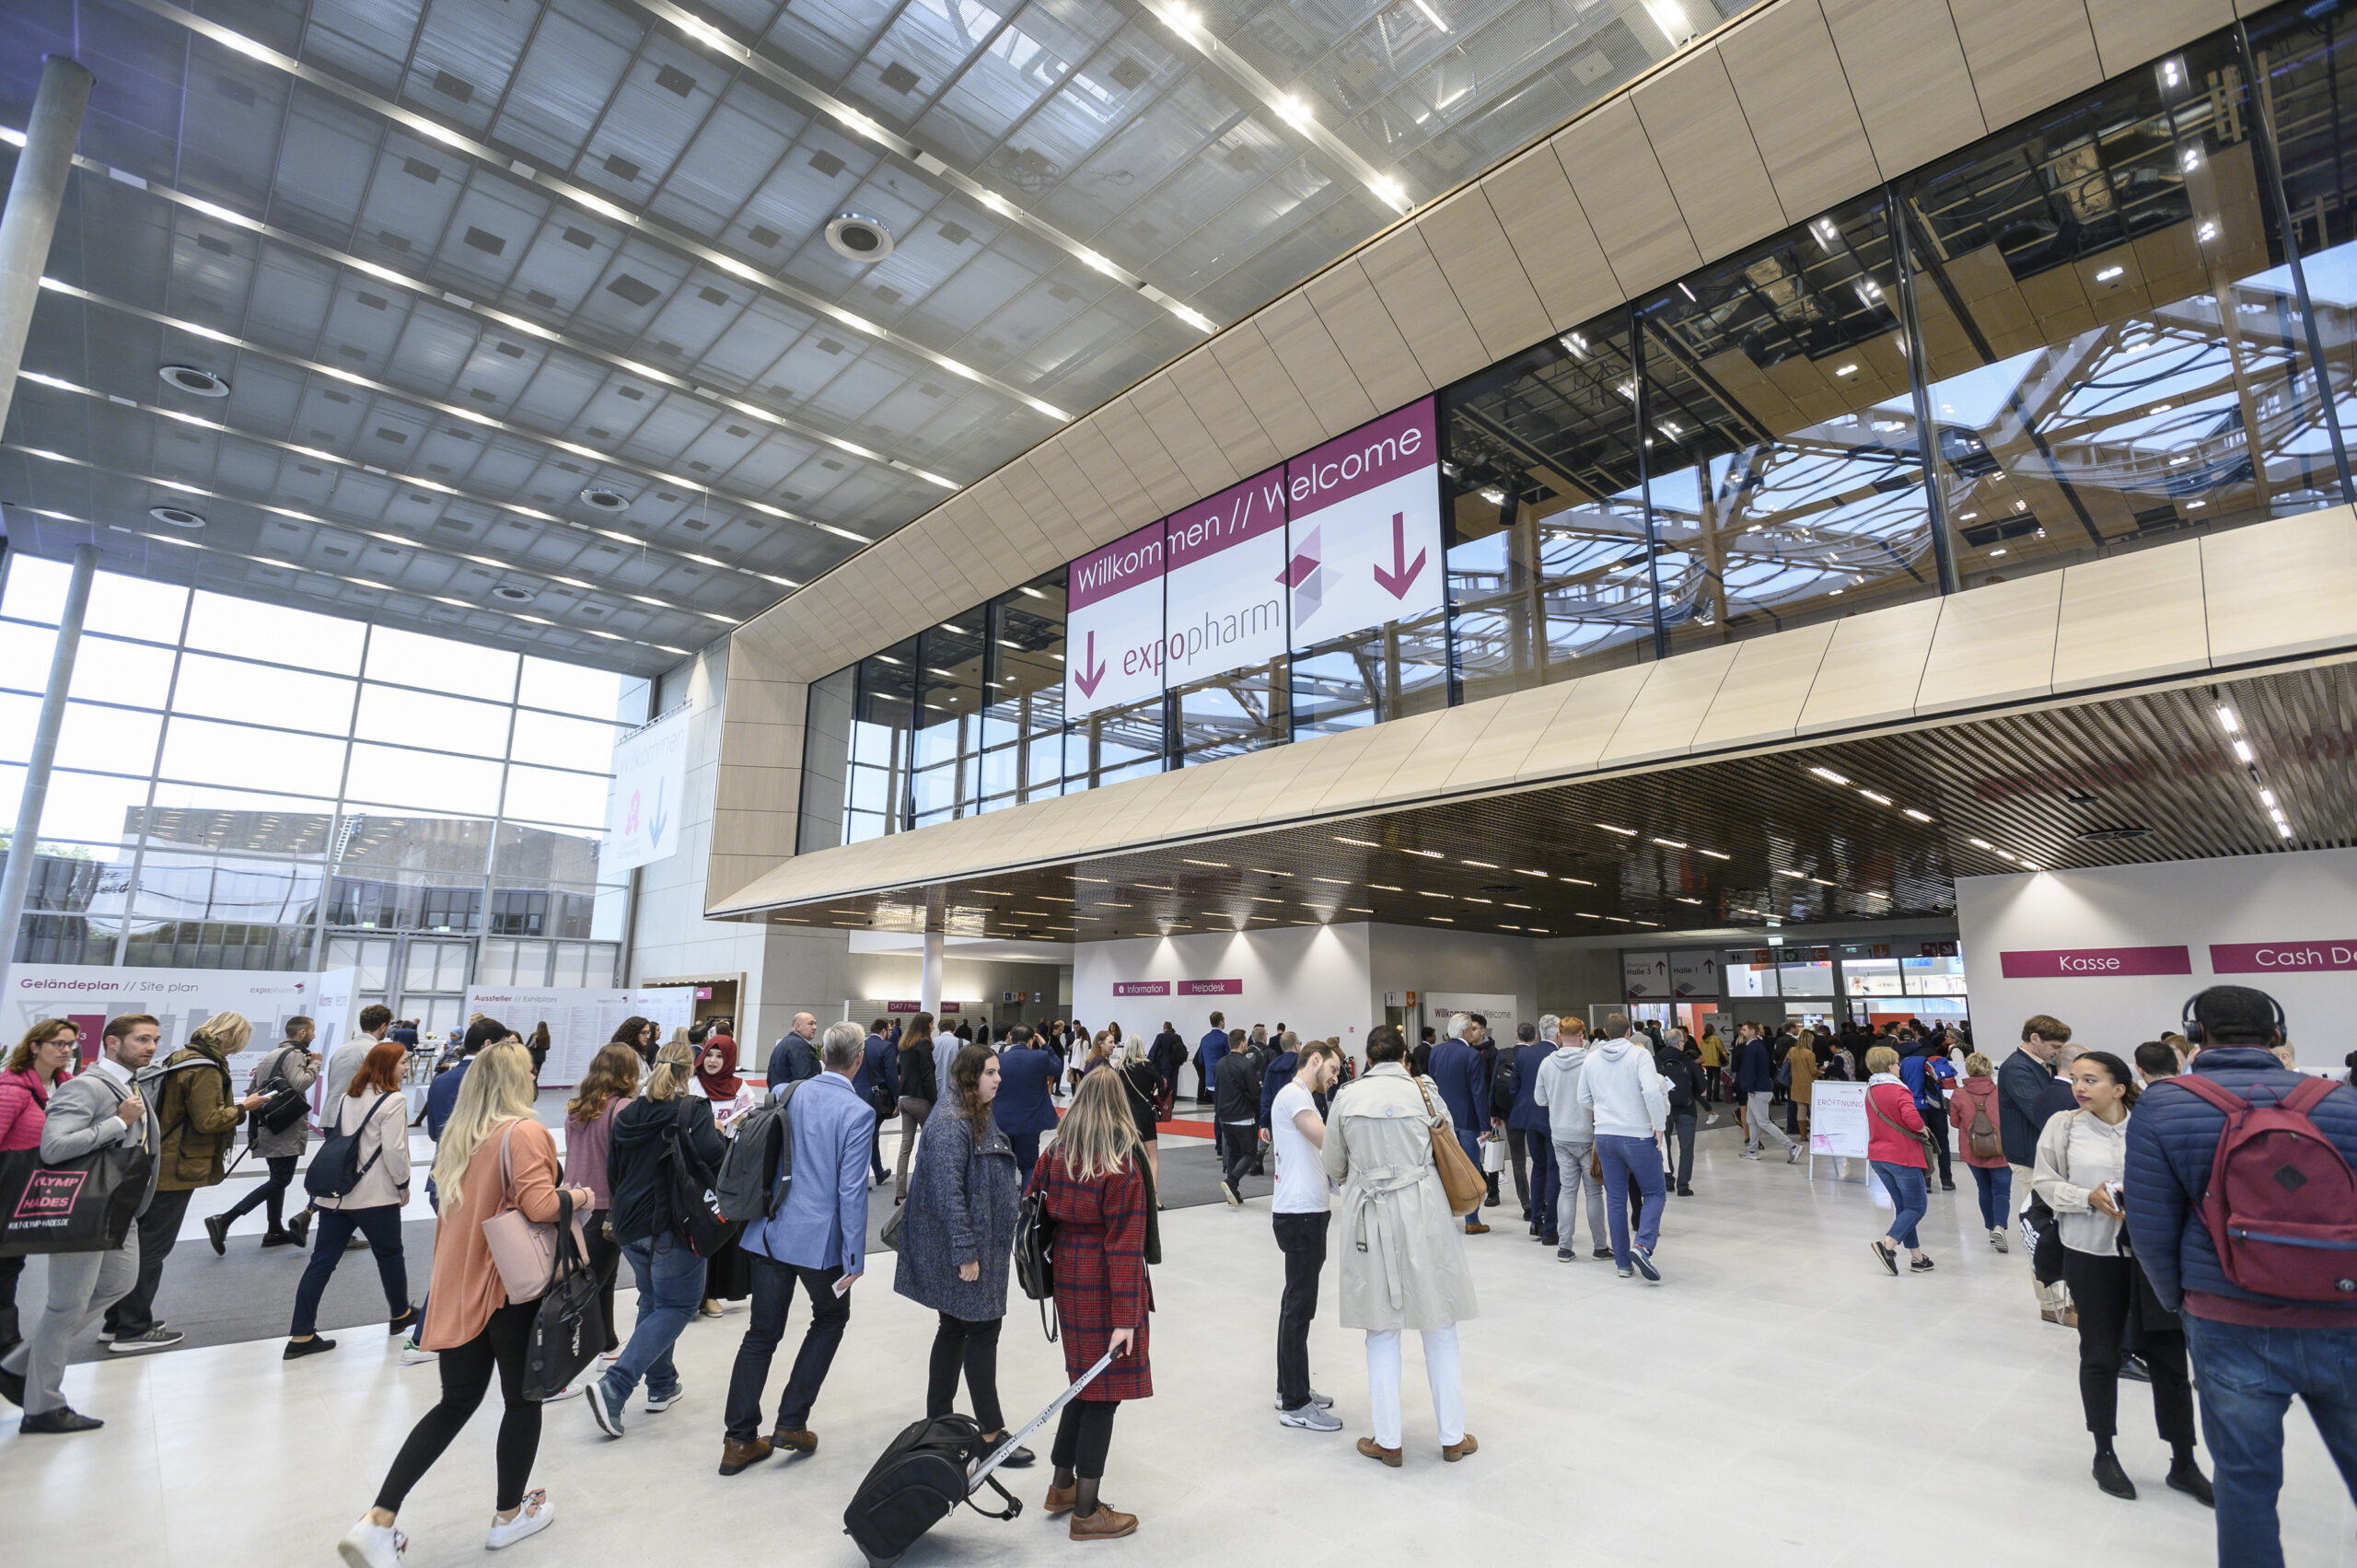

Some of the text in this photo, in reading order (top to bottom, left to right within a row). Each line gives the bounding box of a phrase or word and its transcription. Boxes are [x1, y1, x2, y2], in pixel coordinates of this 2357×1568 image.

[1077, 427, 1422, 594] Willkommen // Welcome
[1123, 599, 1280, 677] expopharm
[2255, 947, 2357, 967] Cash D
[2059, 956, 2121, 971] Kasse
[20, 979, 119, 992] Geländeplan
[139, 981, 164, 992] Site
[168, 982, 199, 993] plan
[1127, 984, 1164, 993] Information
[1191, 983, 1225, 994] Helpdesk
[474, 994, 512, 1003] Aussteller
[523, 995, 558, 1004] Exhibitors
[1482, 1009, 1512, 1018] Welcome
[1817, 1098, 1864, 1108] ERÖFFNUNG
[23, 1196, 69, 1208] HADES
